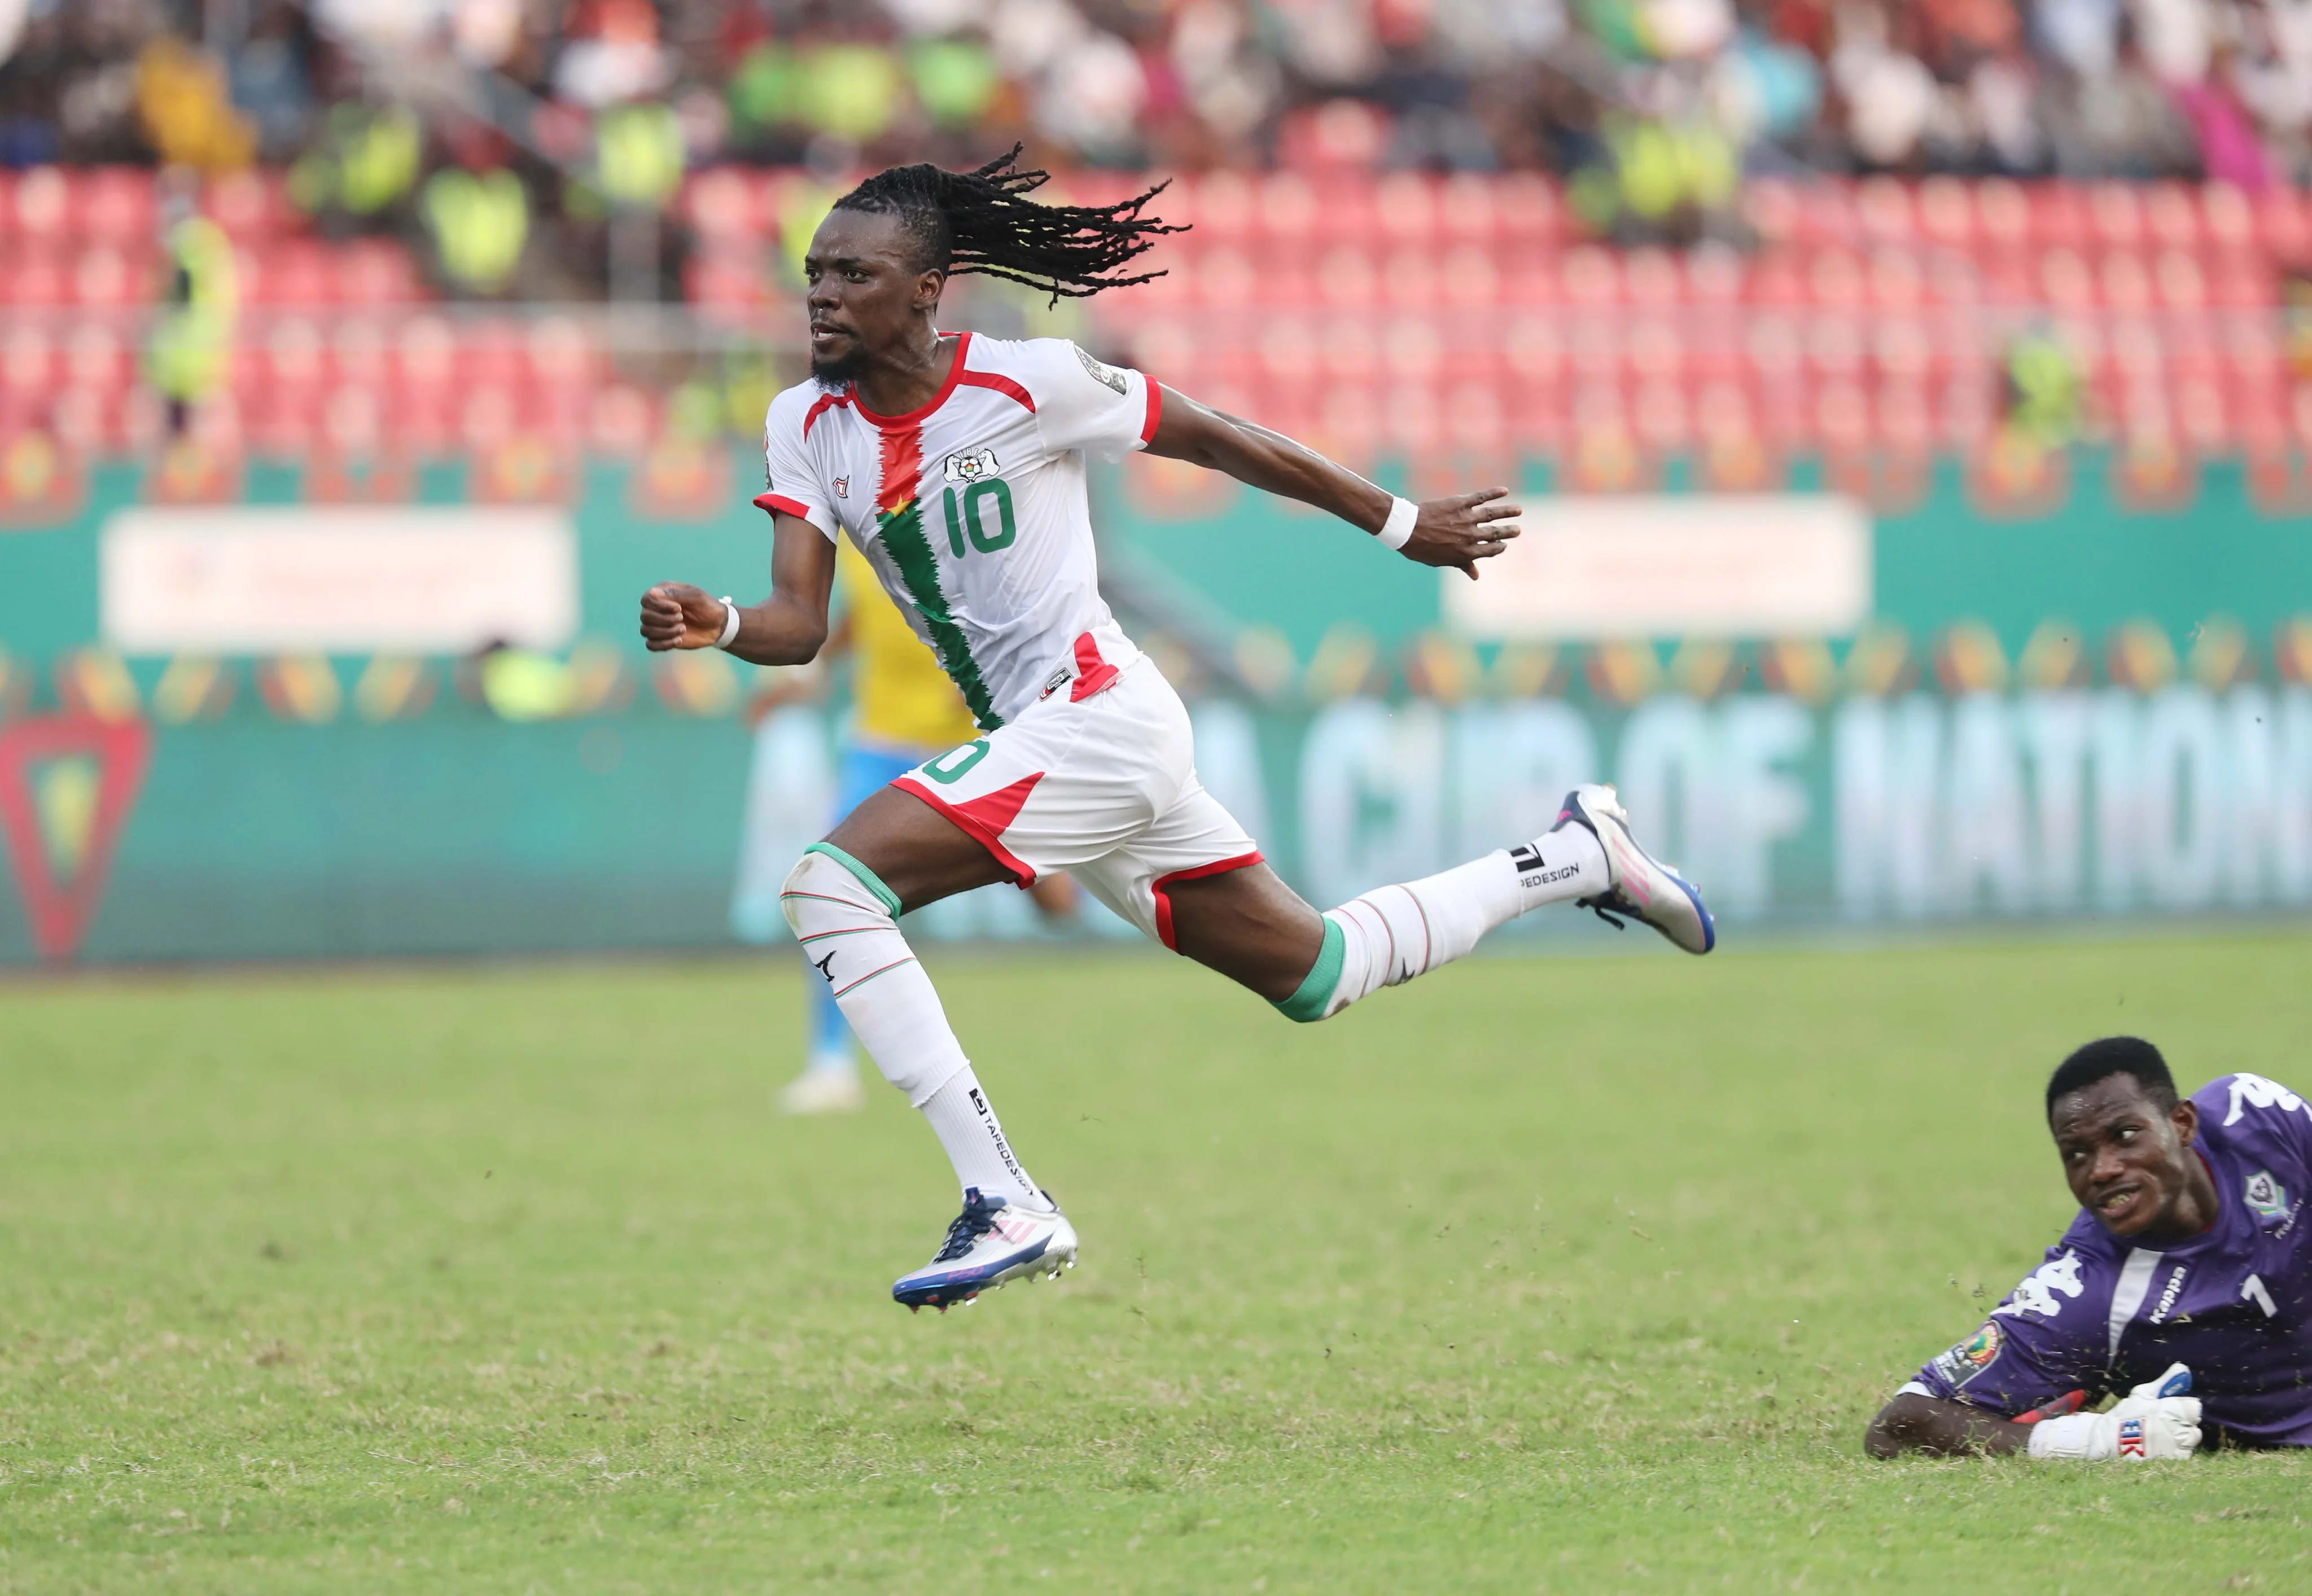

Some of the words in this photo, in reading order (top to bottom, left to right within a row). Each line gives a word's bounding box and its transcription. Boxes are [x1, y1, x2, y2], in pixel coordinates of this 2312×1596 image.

[959, 447, 980, 458] FBF
[943, 478, 1016, 559] 10
[1613, 691, 1819, 920] OF
[2149, 1266, 2187, 1325] Kappa
[2240, 1273, 2278, 1318] 1
